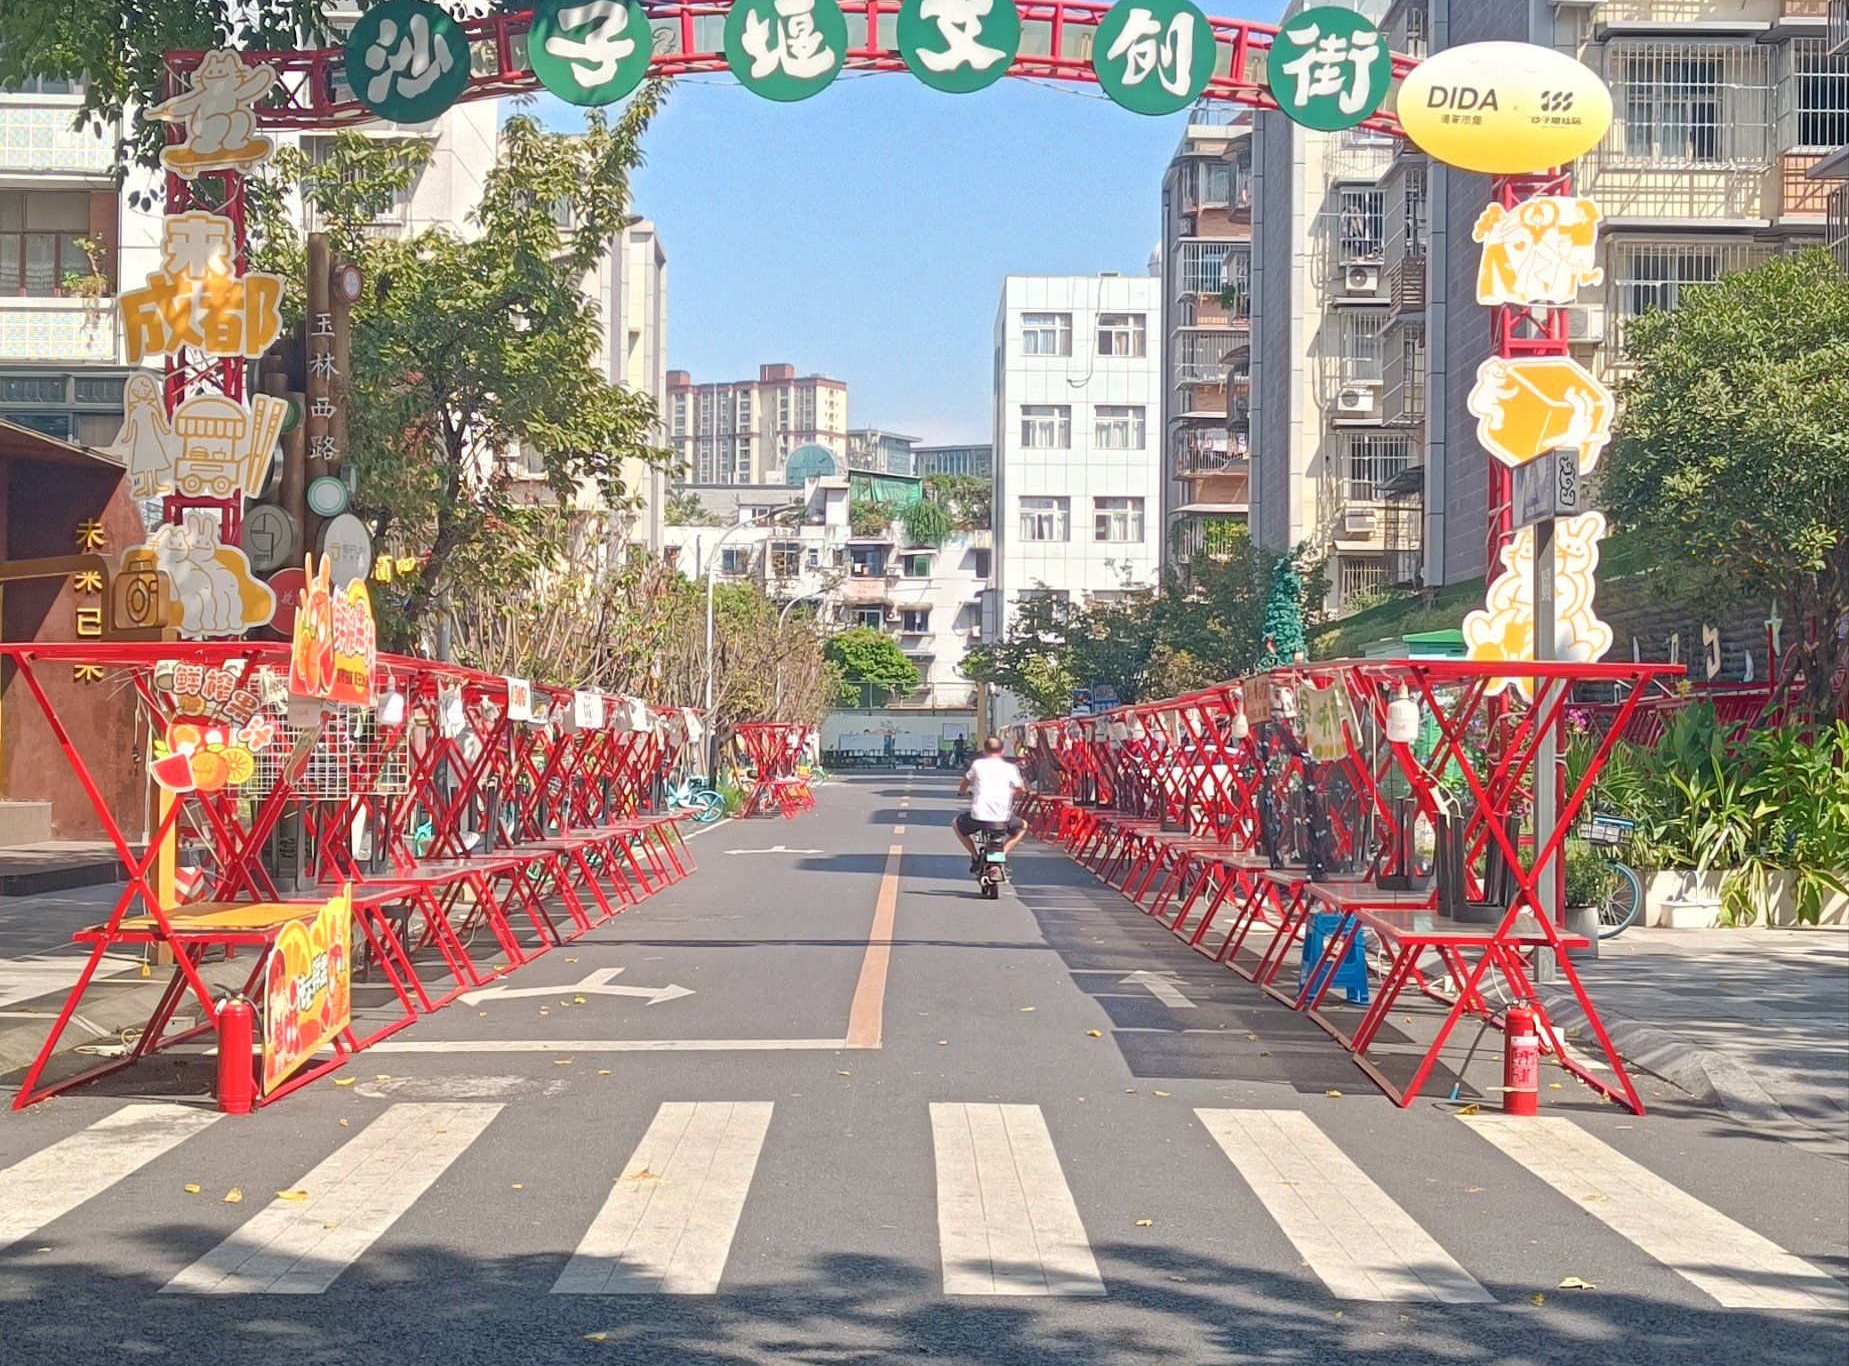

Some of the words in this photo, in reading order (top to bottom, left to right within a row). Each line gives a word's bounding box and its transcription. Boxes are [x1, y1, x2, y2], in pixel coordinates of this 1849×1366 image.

[1427, 86, 1498, 111] DIDA
[166, 217, 230, 278] 来
[121, 274, 282, 364] 成都
[309, 312, 341, 461] 玉林西路
[174, 664, 274, 751] 鲜榨果汁
